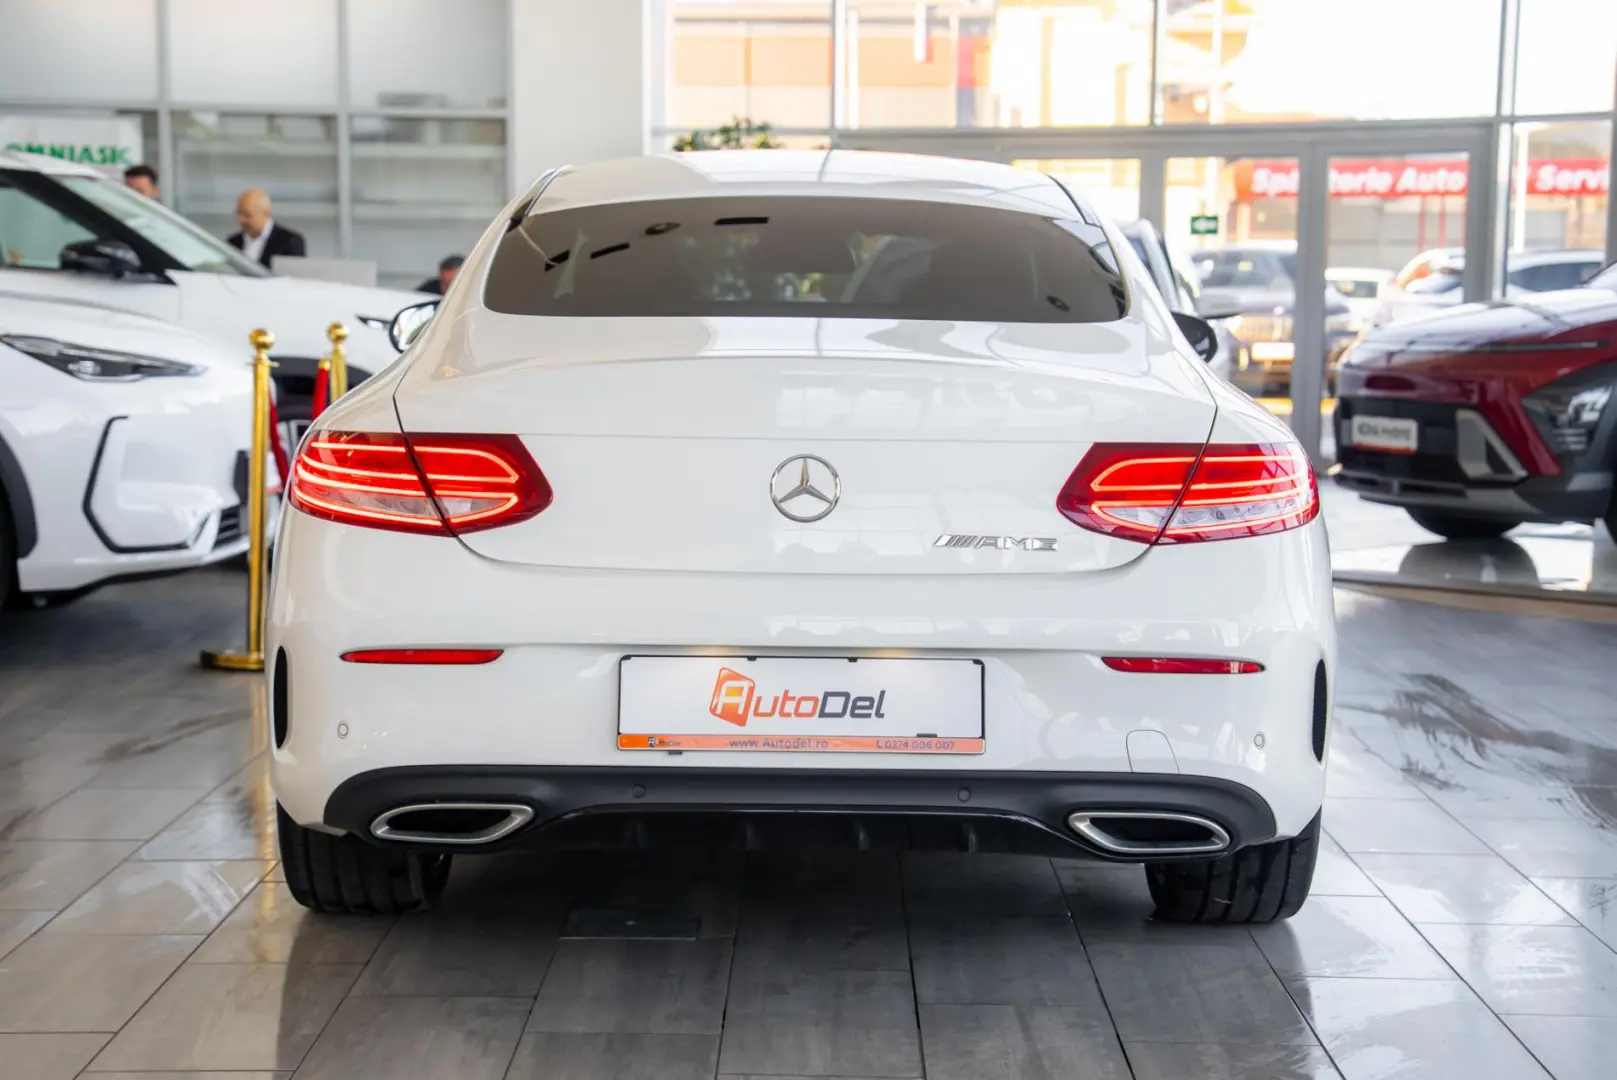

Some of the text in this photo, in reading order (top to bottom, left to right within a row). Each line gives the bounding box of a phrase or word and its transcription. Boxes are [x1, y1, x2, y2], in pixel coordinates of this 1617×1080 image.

[1396, 167, 1467, 193] Auto
[974, 535, 1058, 551] AMG
[714, 679, 887, 720] AutoDel
